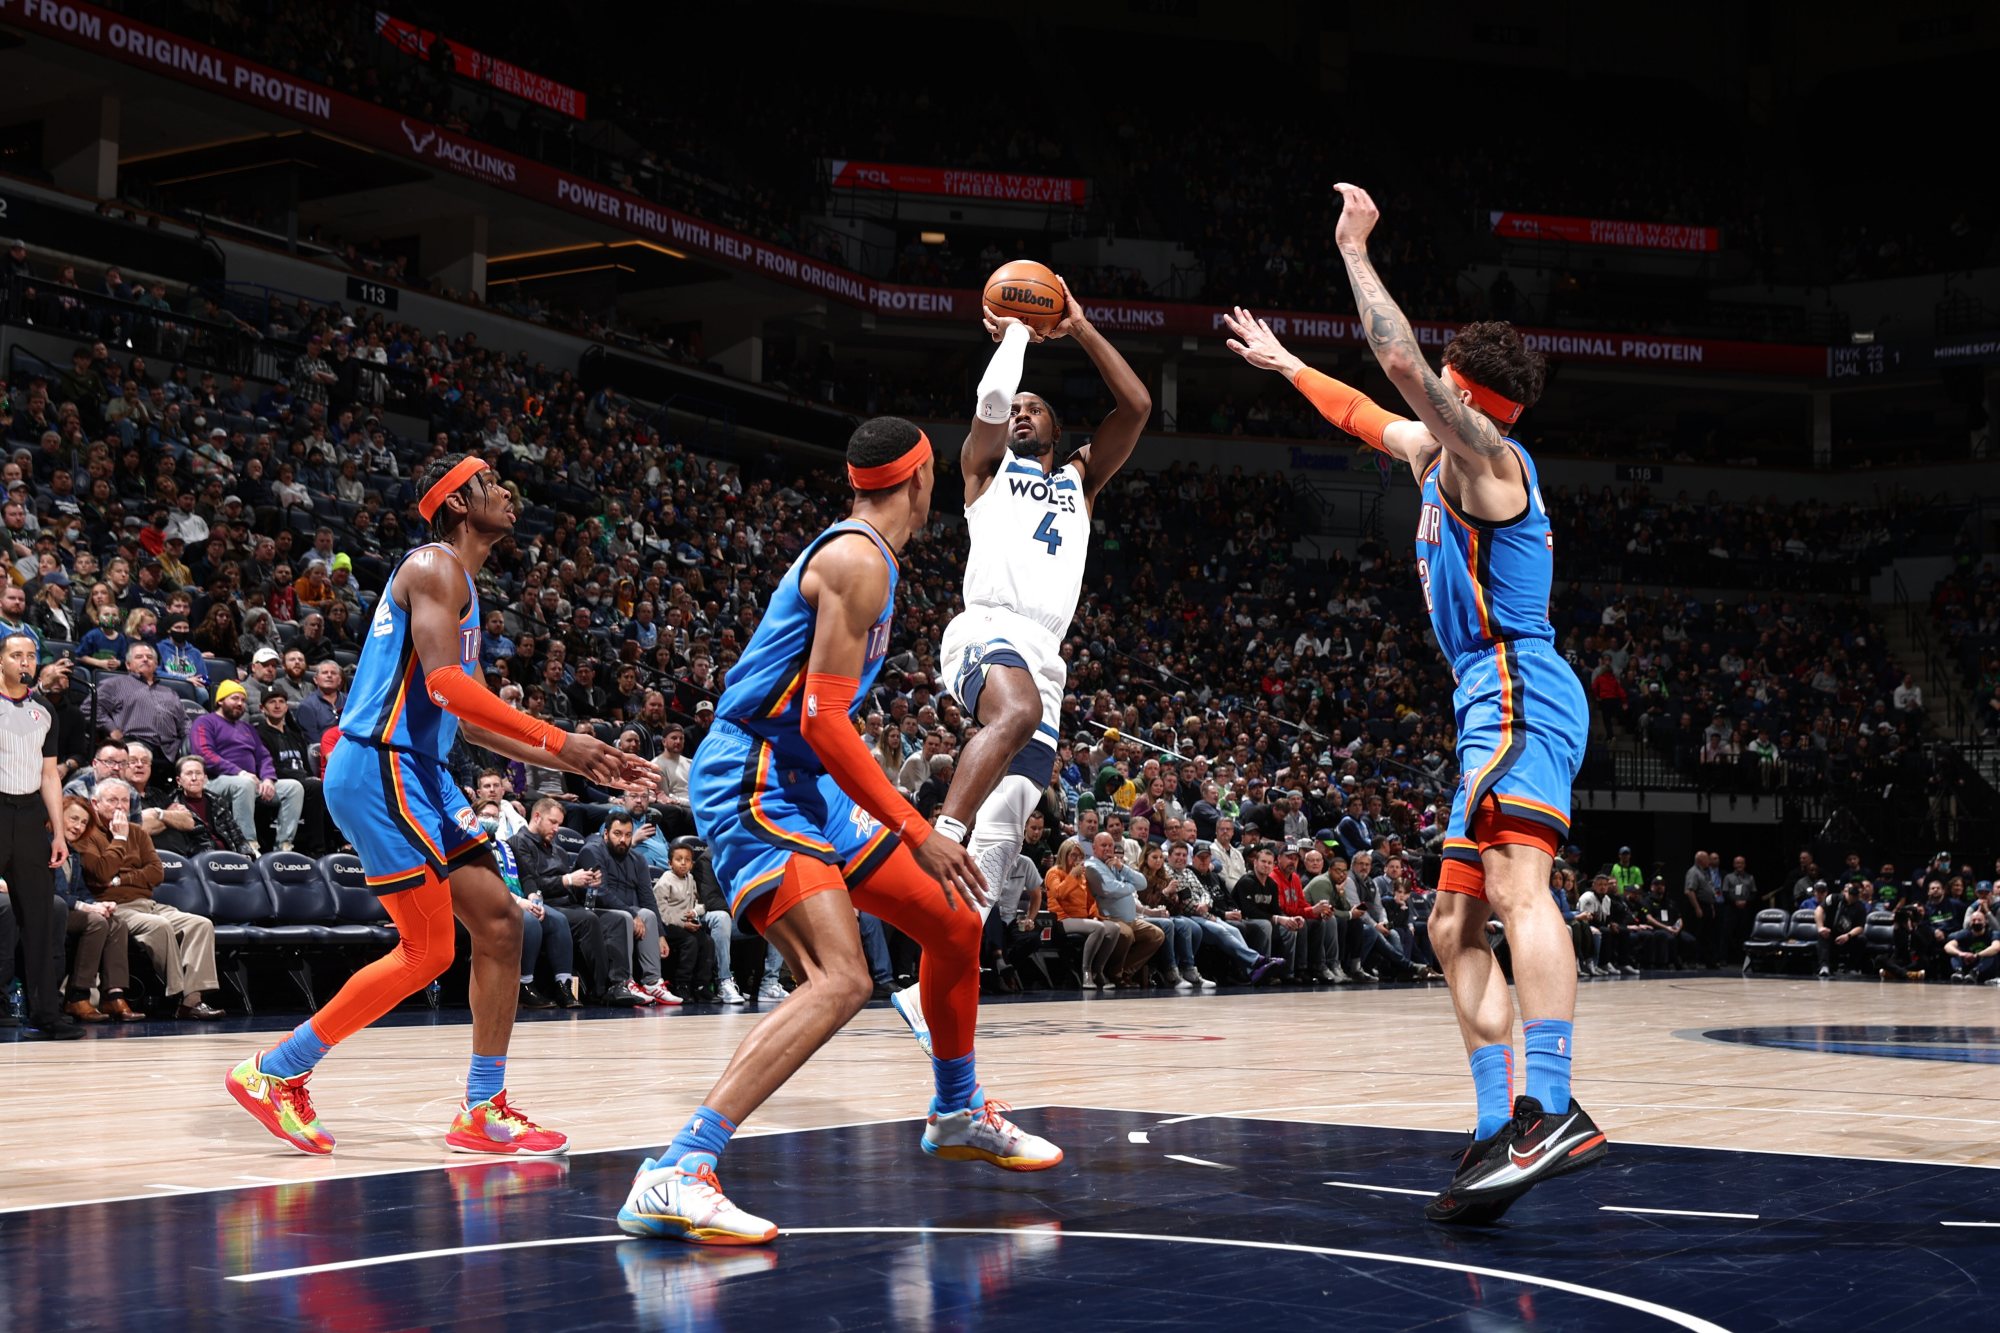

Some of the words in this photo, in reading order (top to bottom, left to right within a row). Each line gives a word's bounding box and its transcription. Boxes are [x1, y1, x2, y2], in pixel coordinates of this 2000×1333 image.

[23, 0, 102, 41] FROM
[107, 22, 228, 85] ORIGINAL
[234, 66, 331, 120] PROTEIN
[471, 63, 576, 117] TBERWOLVES
[434, 136, 472, 168] JACK
[857, 169, 890, 185] TCL
[943, 170, 1001, 186] OFFICIAL
[1006, 175, 1021, 187] TV
[1024, 177, 1042, 188] OF
[1051, 179, 1072, 190] THE
[943, 182, 1072, 201] TIMBERWOLVES
[1511, 219, 1541, 232] TCL
[1590, 219, 1641, 233] OFFICIAL
[1646, 223, 1660, 234] TV
[1664, 225, 1680, 236] OF
[557, 179, 620, 218] POWER
[625, 202, 668, 233] THRU
[671, 218, 710, 248] WITH
[714, 235, 753, 262] HELP
[756, 248, 798, 279] FROM
[801, 264, 866, 301] ORIGINAL
[869, 287, 953, 312] PROTEIN
[1590, 230, 1706, 250] TIMBERWOLVES
[360, 283, 386, 305] 113
[1001, 286, 1054, 309] Wilson
[1084, 305, 1117, 324] ACK
[1292, 318, 1345, 338] THRU
[1523, 334, 1617, 357] ORIGINAL
[1621, 340, 1703, 363] PROTEIN
[1835, 348, 1860, 362] NYK
[1866, 345, 1884, 360] 22
[1835, 363, 1861, 377] DAL
[1867, 360, 1884, 375] 13
[1628, 467, 1652, 480] 118
[1009, 478, 1076, 513] WOLES
[1032, 511, 1063, 556] 4
[219, 863, 249, 871] LEXUS
[283, 863, 311, 871] LEXUS
